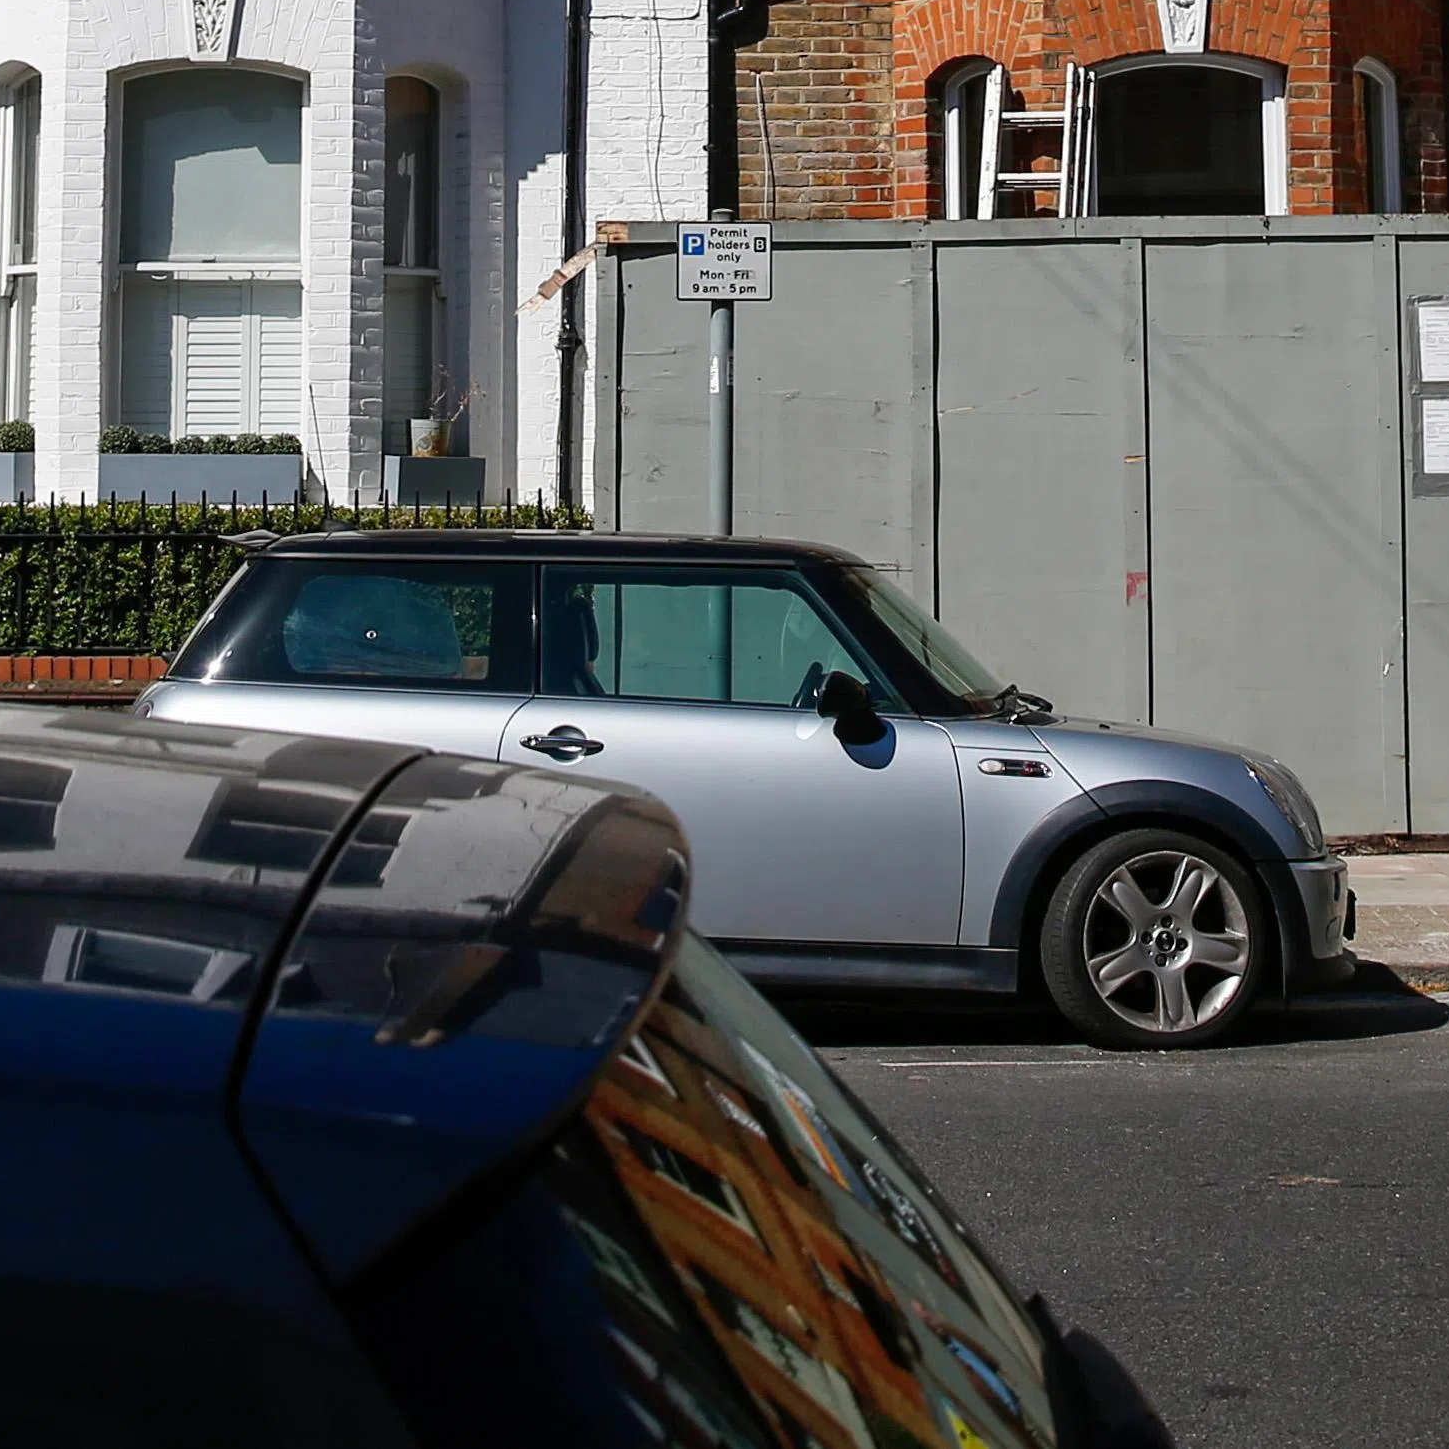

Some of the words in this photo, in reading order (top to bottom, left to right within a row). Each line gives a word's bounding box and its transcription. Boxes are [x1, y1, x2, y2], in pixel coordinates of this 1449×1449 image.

[710, 228, 748, 238] Permit
[687, 236, 702, 253] P
[707, 240, 750, 250] holders
[755, 239, 765, 251] B
[716, 253, 741, 263] only
[699, 270, 725, 280] Mon
[734, 270, 749, 280] Fri
[692, 283, 700, 293] 9
[729, 283, 737, 293] 5
[739, 286, 757, 295] pm
